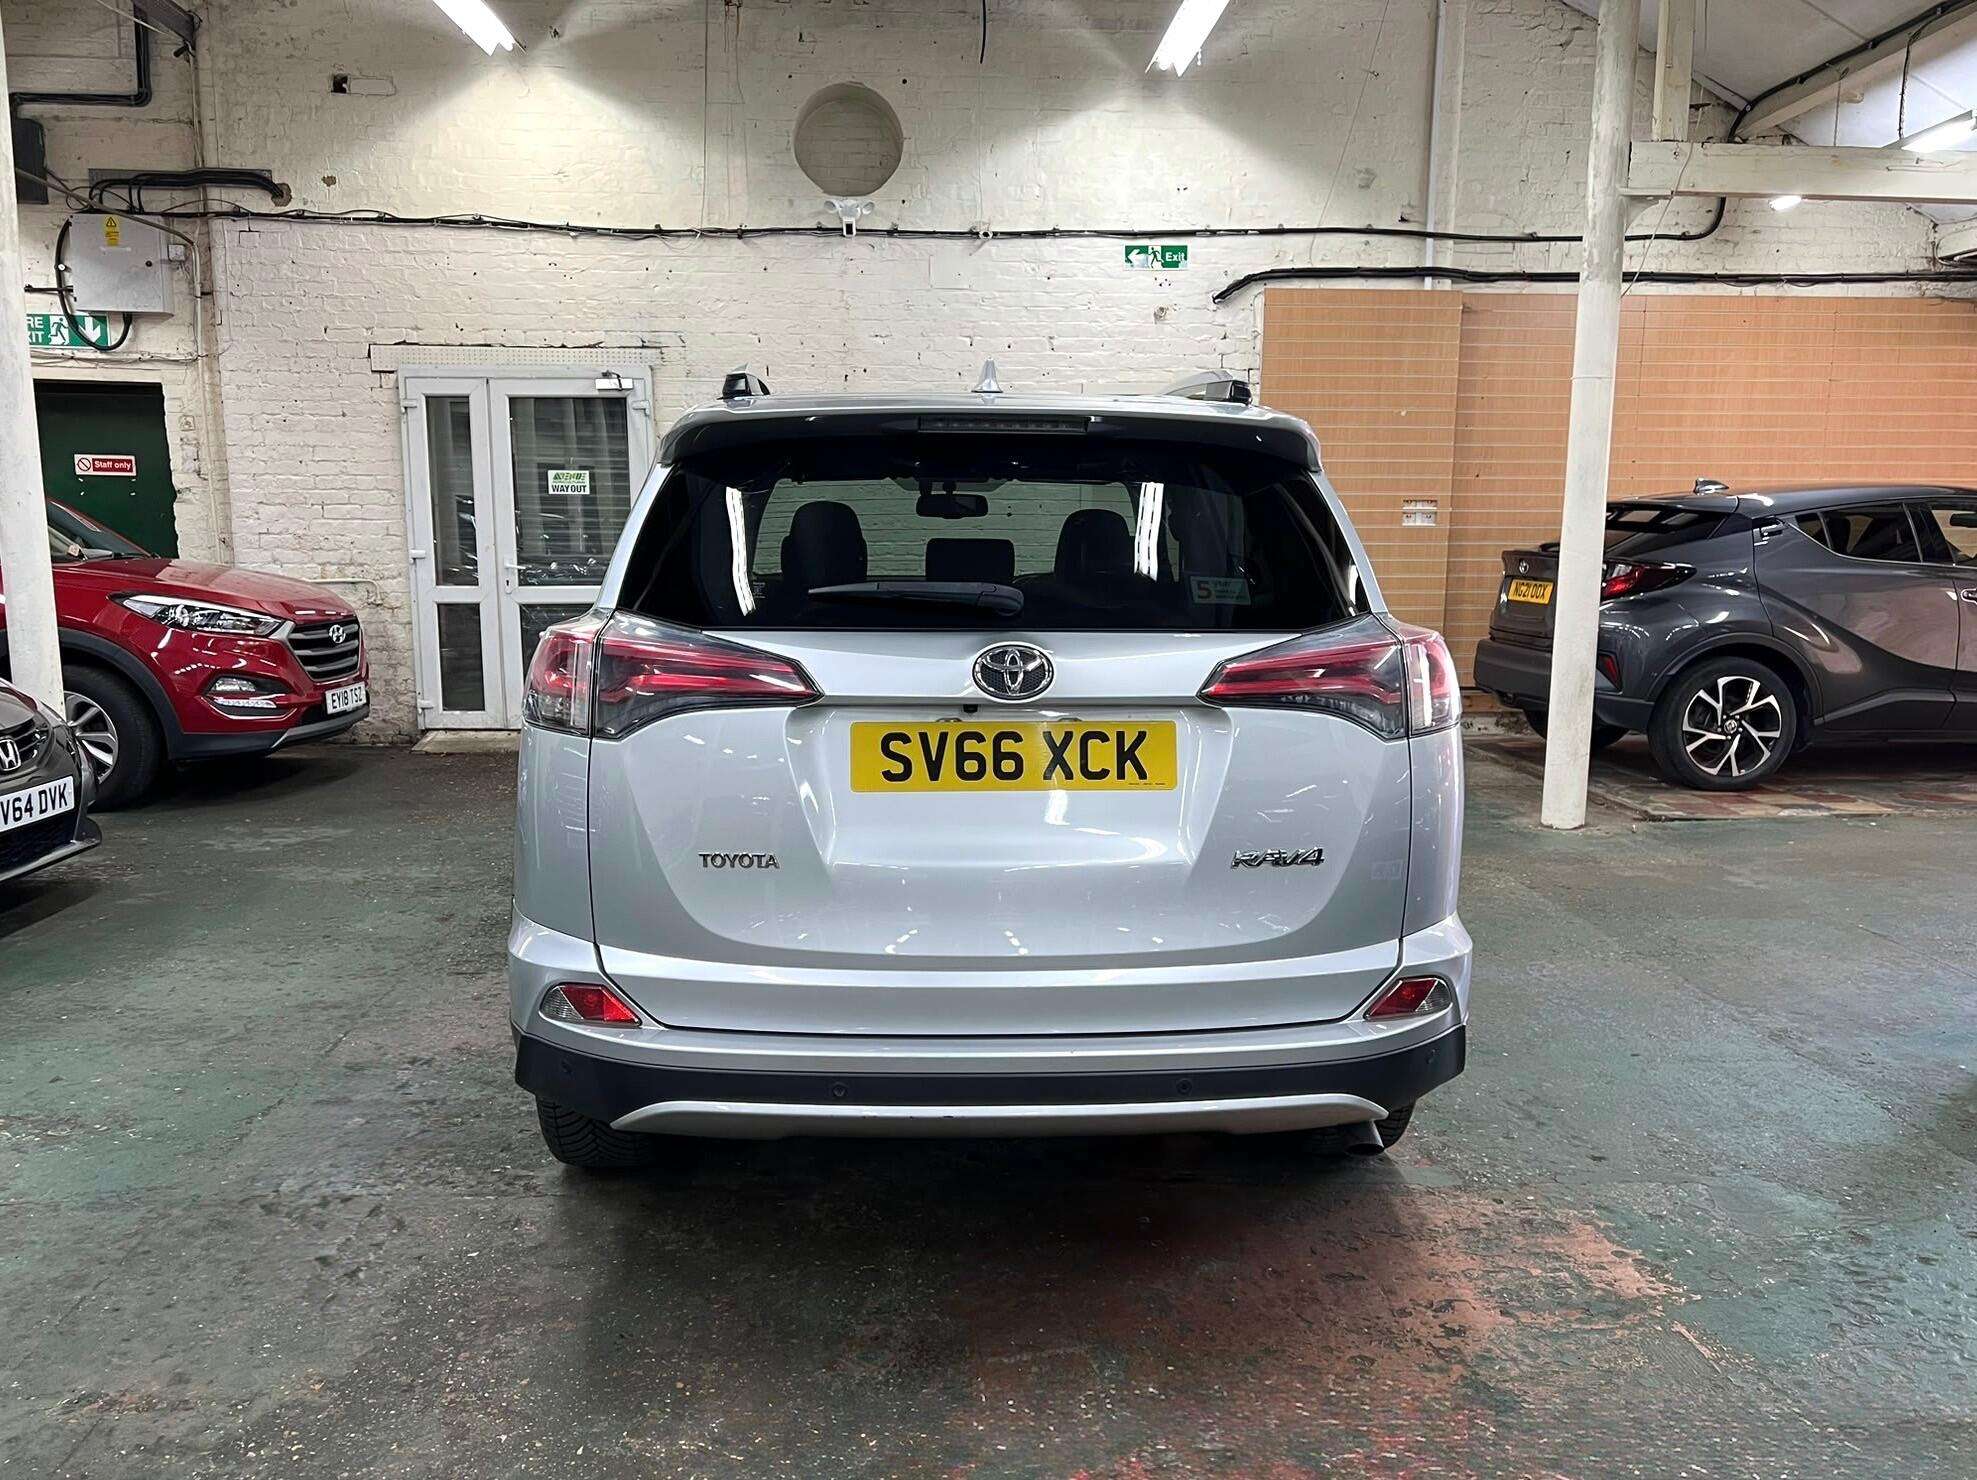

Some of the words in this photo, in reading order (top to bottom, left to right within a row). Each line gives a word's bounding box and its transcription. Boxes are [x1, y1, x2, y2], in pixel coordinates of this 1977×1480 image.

[1165, 251, 1185, 262] Exit
[94, 460, 113, 469] Staff
[114, 461, 131, 471] only
[551, 485, 569, 493] WAY
[570, 485, 587, 493] OUT
[880, 730, 1024, 782] SV66
[1042, 730, 1148, 781] XCK
[0, 793, 33, 826] V64
[38, 782, 68, 815] DVK
[698, 852, 780, 869] TOYOTA
[1231, 846, 1325, 869] RAV4
